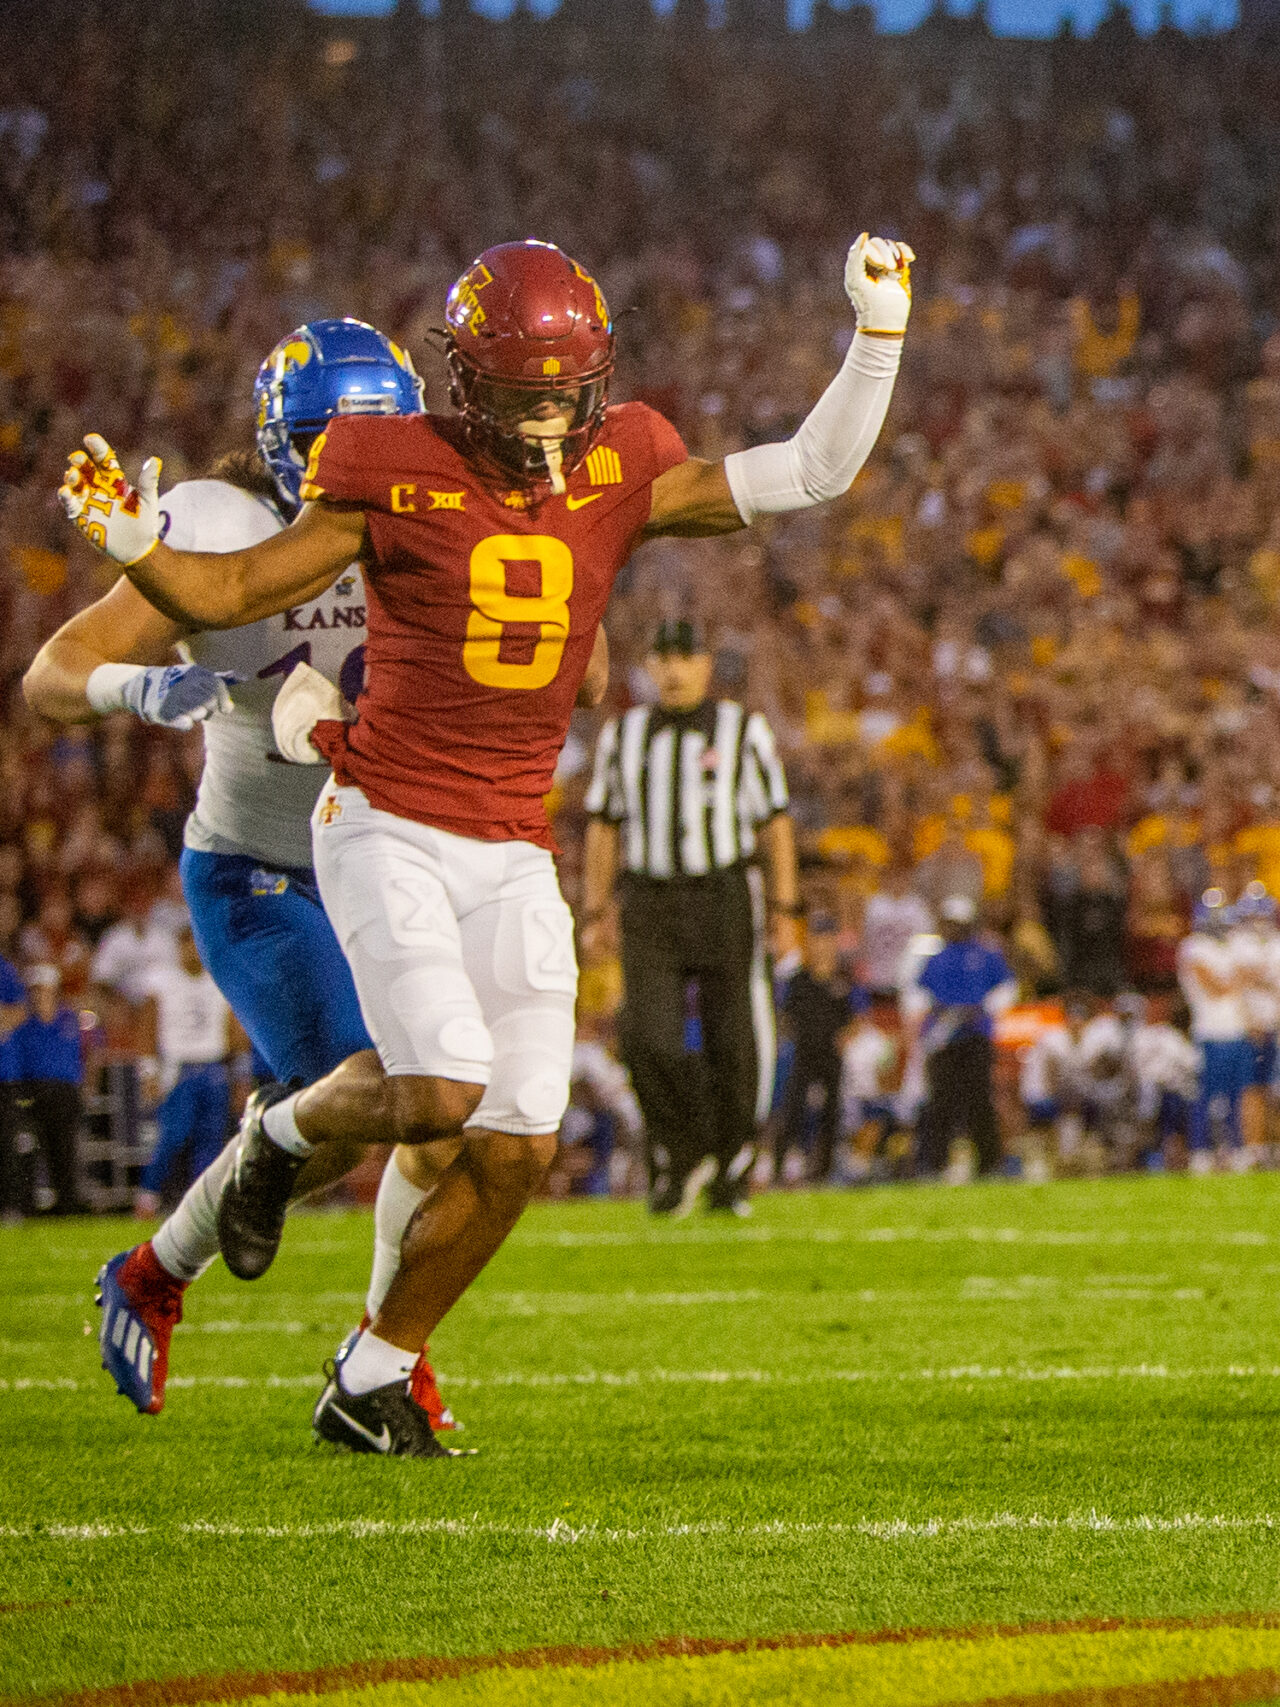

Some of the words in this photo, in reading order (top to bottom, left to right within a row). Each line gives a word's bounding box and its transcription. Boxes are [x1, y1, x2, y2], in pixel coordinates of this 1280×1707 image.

[391, 483, 417, 513] C
[284, 605, 366, 631] KANS
[462, 534, 574, 690] 8
